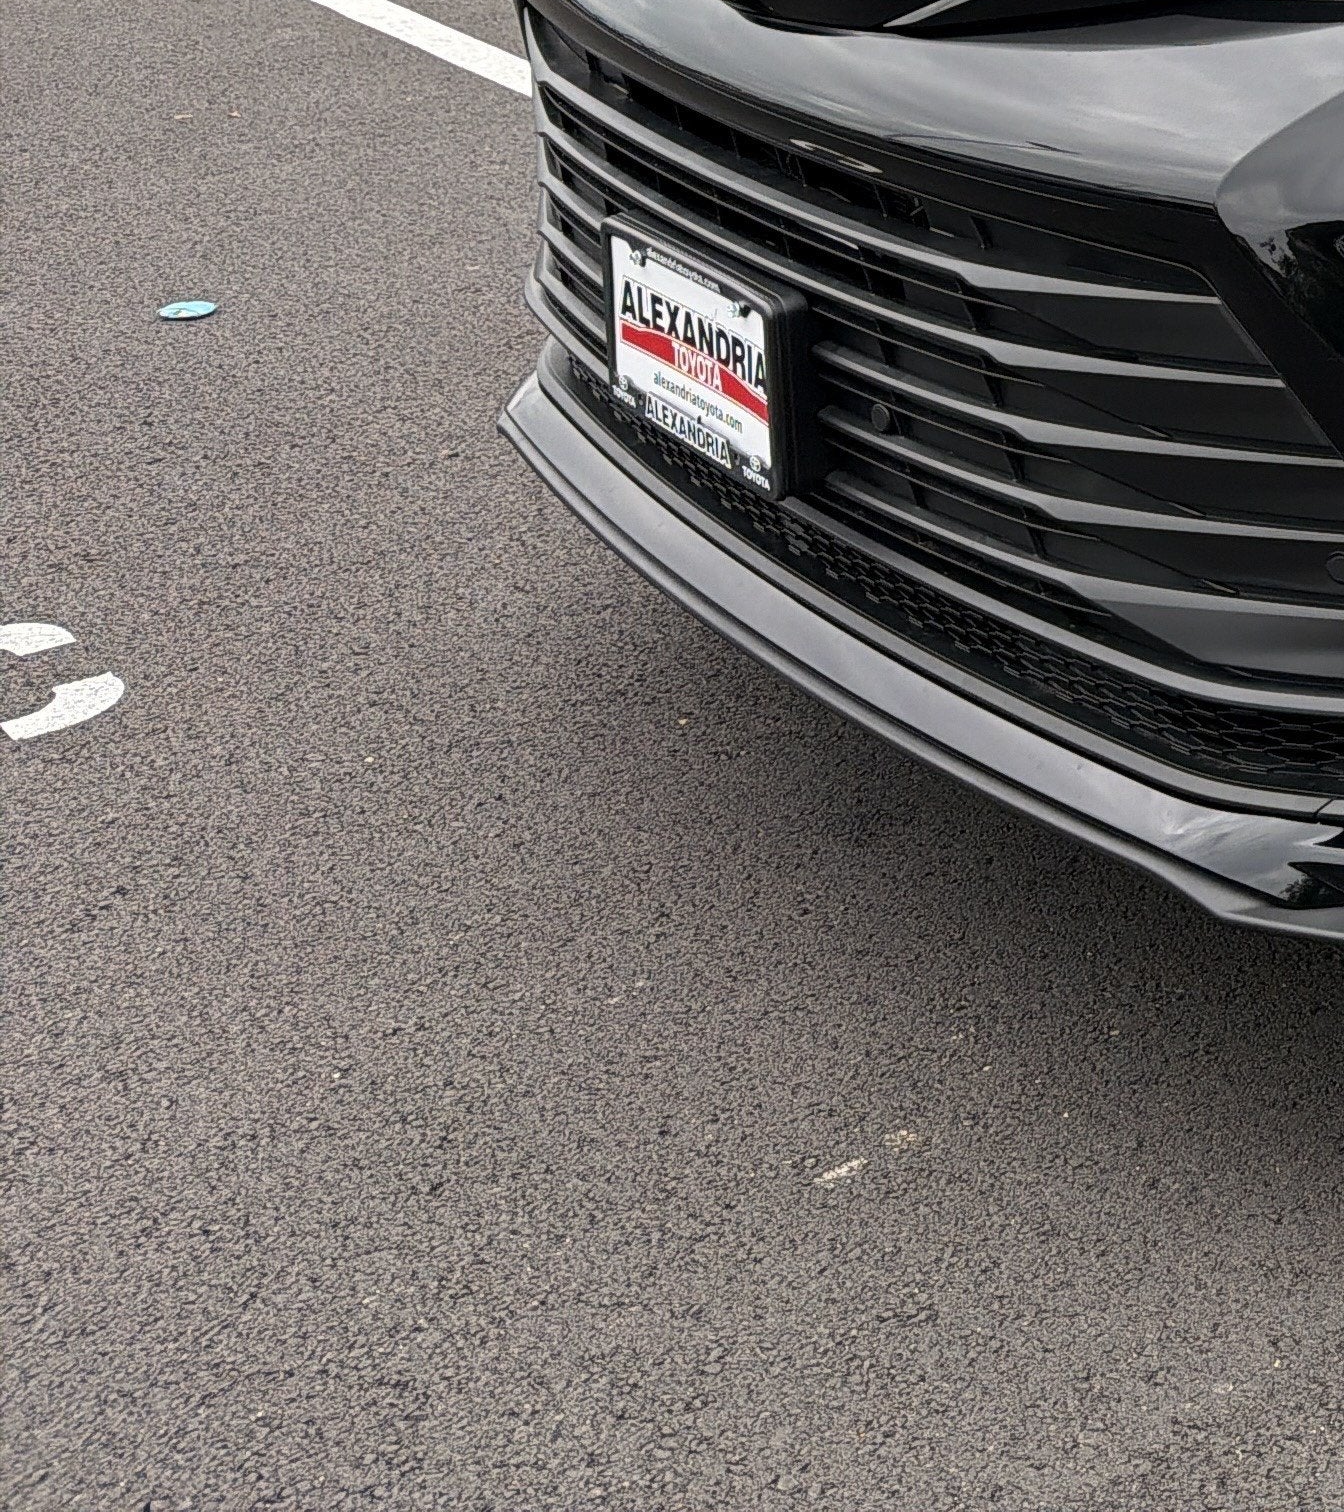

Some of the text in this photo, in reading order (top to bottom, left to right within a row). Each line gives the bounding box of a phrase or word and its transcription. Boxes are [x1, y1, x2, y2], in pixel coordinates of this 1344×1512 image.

[621, 280, 767, 390] ALEXANDRIA
[672, 340, 723, 391] TOYOTA
[612, 385, 637, 408] TOYOTA
[653, 371, 743, 433] alexandriatoyota.com
[645, 393, 731, 469] ALEXANDRIA
[742, 465, 771, 491] TOYOTA
